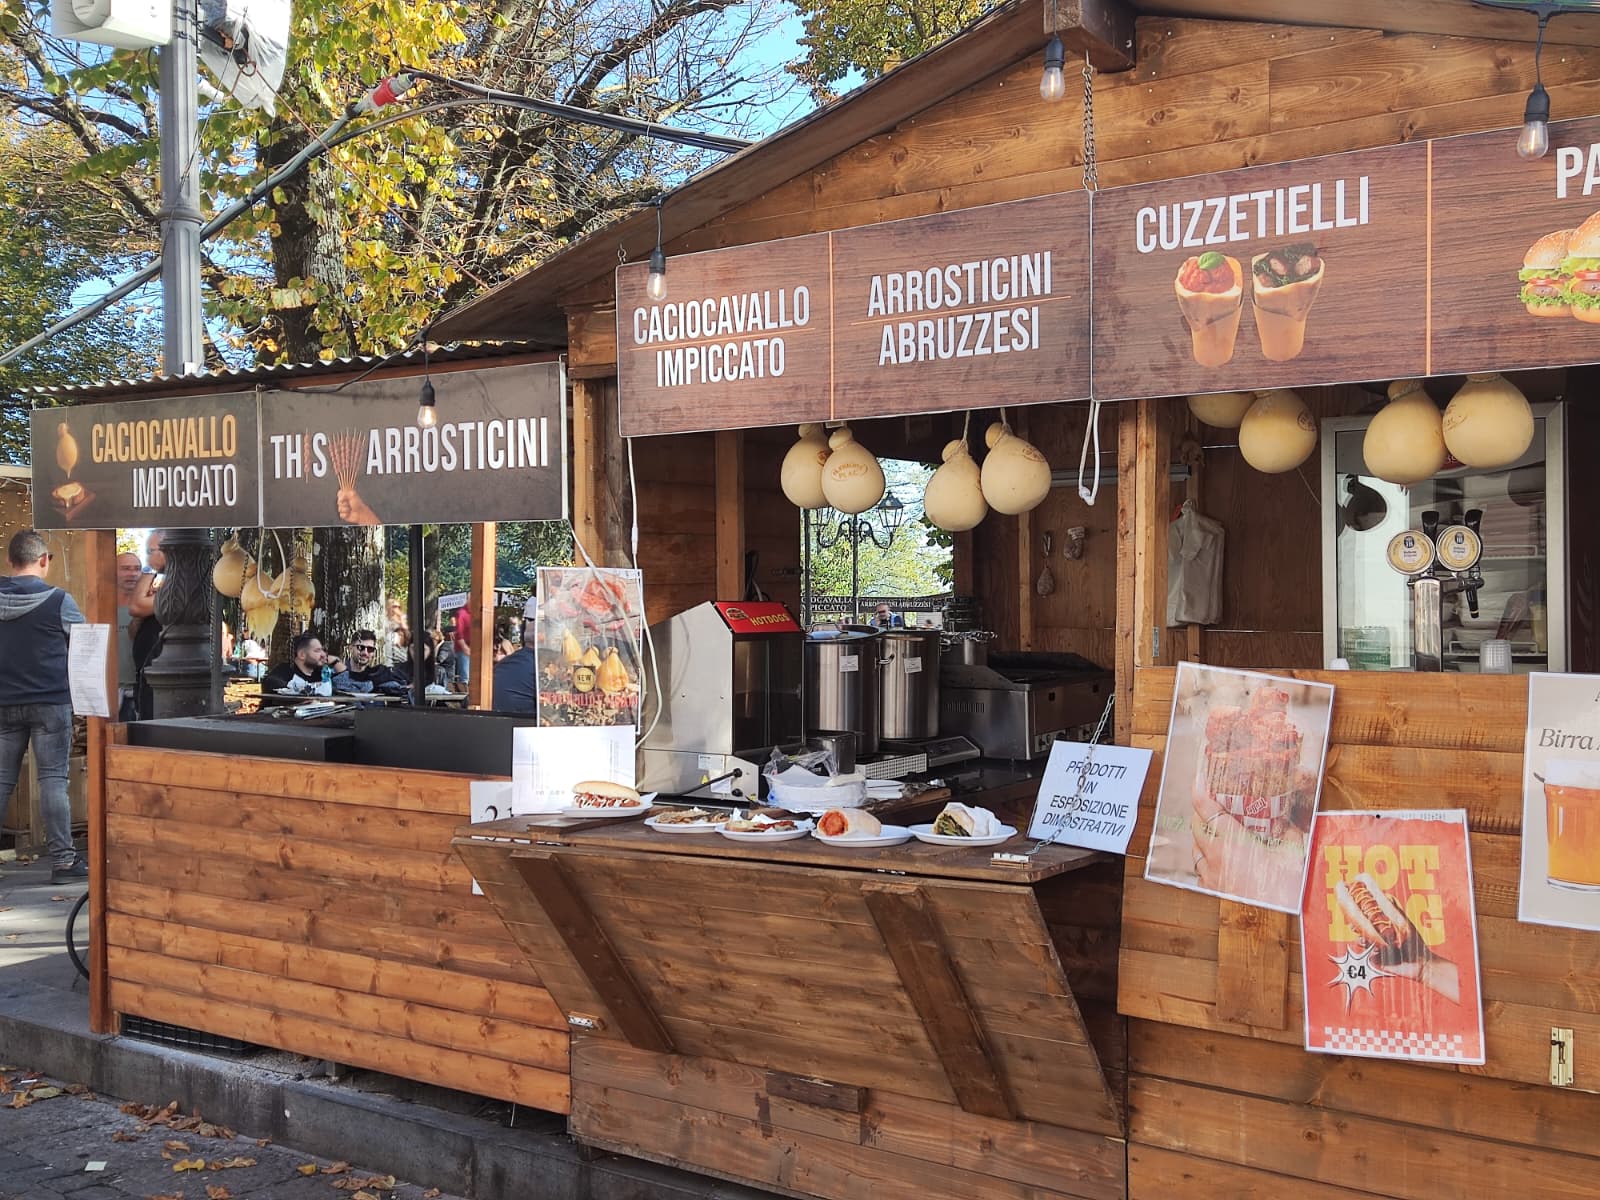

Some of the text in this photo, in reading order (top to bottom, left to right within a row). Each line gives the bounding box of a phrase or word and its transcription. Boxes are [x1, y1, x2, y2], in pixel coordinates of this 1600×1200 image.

[1136, 175, 1370, 254] CUZZETIELLI
[867, 251, 1052, 317] ARROSTICINI
[633, 285, 810, 345] CACIOCAVALLO
[879, 306, 1040, 366] ABRUZZESI
[656, 337, 785, 388] IMPICCATO
[91, 413, 237, 464] CACIOCAVALLO
[366, 417, 549, 475] ARROSTICINI
[132, 463, 237, 508] IMPICCATO
[750, 613, 791, 626] HOTDOGS
[577, 674, 592, 682] NEW
[1539, 727, 1593, 750] Birra
[1066, 760, 1127, 779] PRODOTTI
[1083, 781, 1098, 794] IN
[1042, 812, 1126, 837] DIMOSTRATIVI
[1050, 794, 1129, 819] ESPOSIZIONE
[1324, 844, 1440, 891] HOT
[1347, 965, 1367, 980] €4
